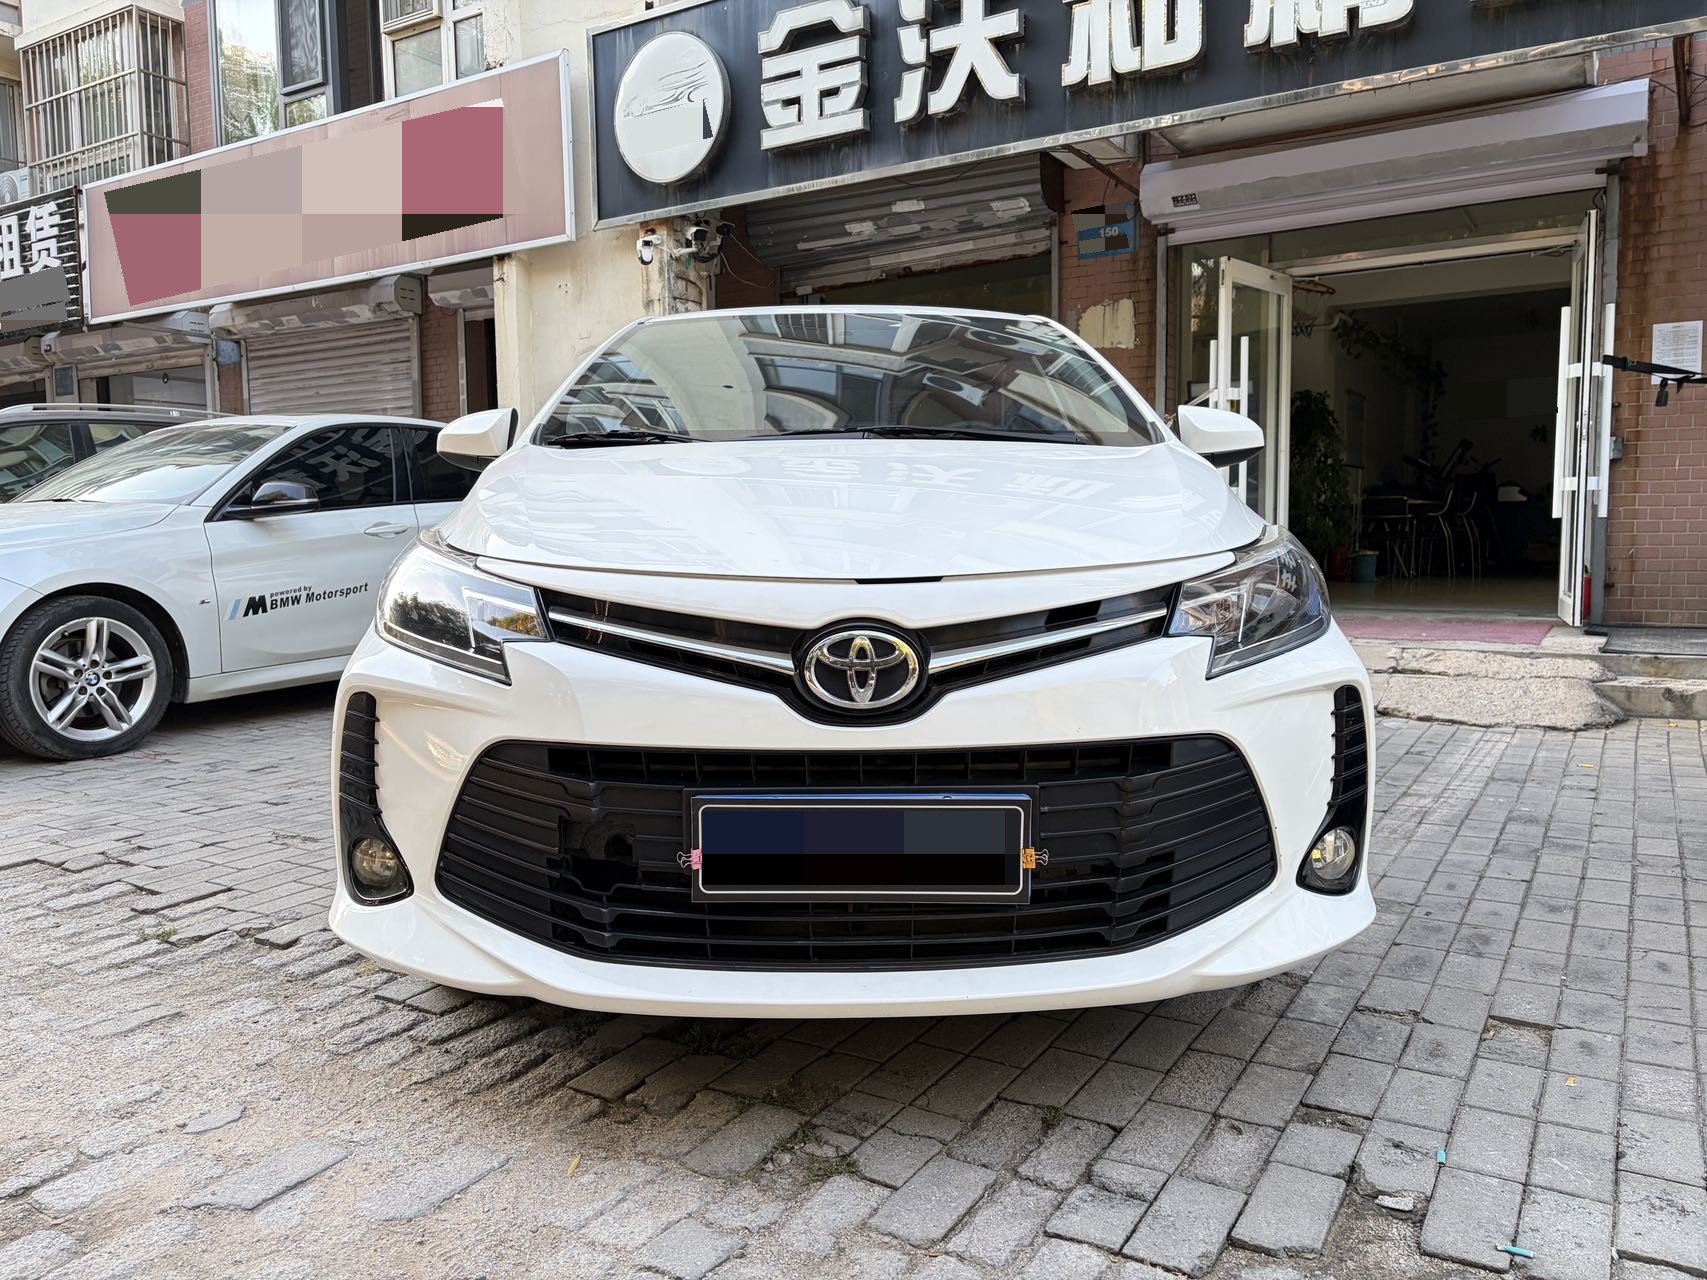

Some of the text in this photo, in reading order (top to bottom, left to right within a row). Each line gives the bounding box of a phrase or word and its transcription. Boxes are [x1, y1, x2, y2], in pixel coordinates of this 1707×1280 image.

[1099, 226, 1119, 238] 150
[270, 584, 312, 598] powered by
[270, 582, 369, 610] BMW Motorsport
